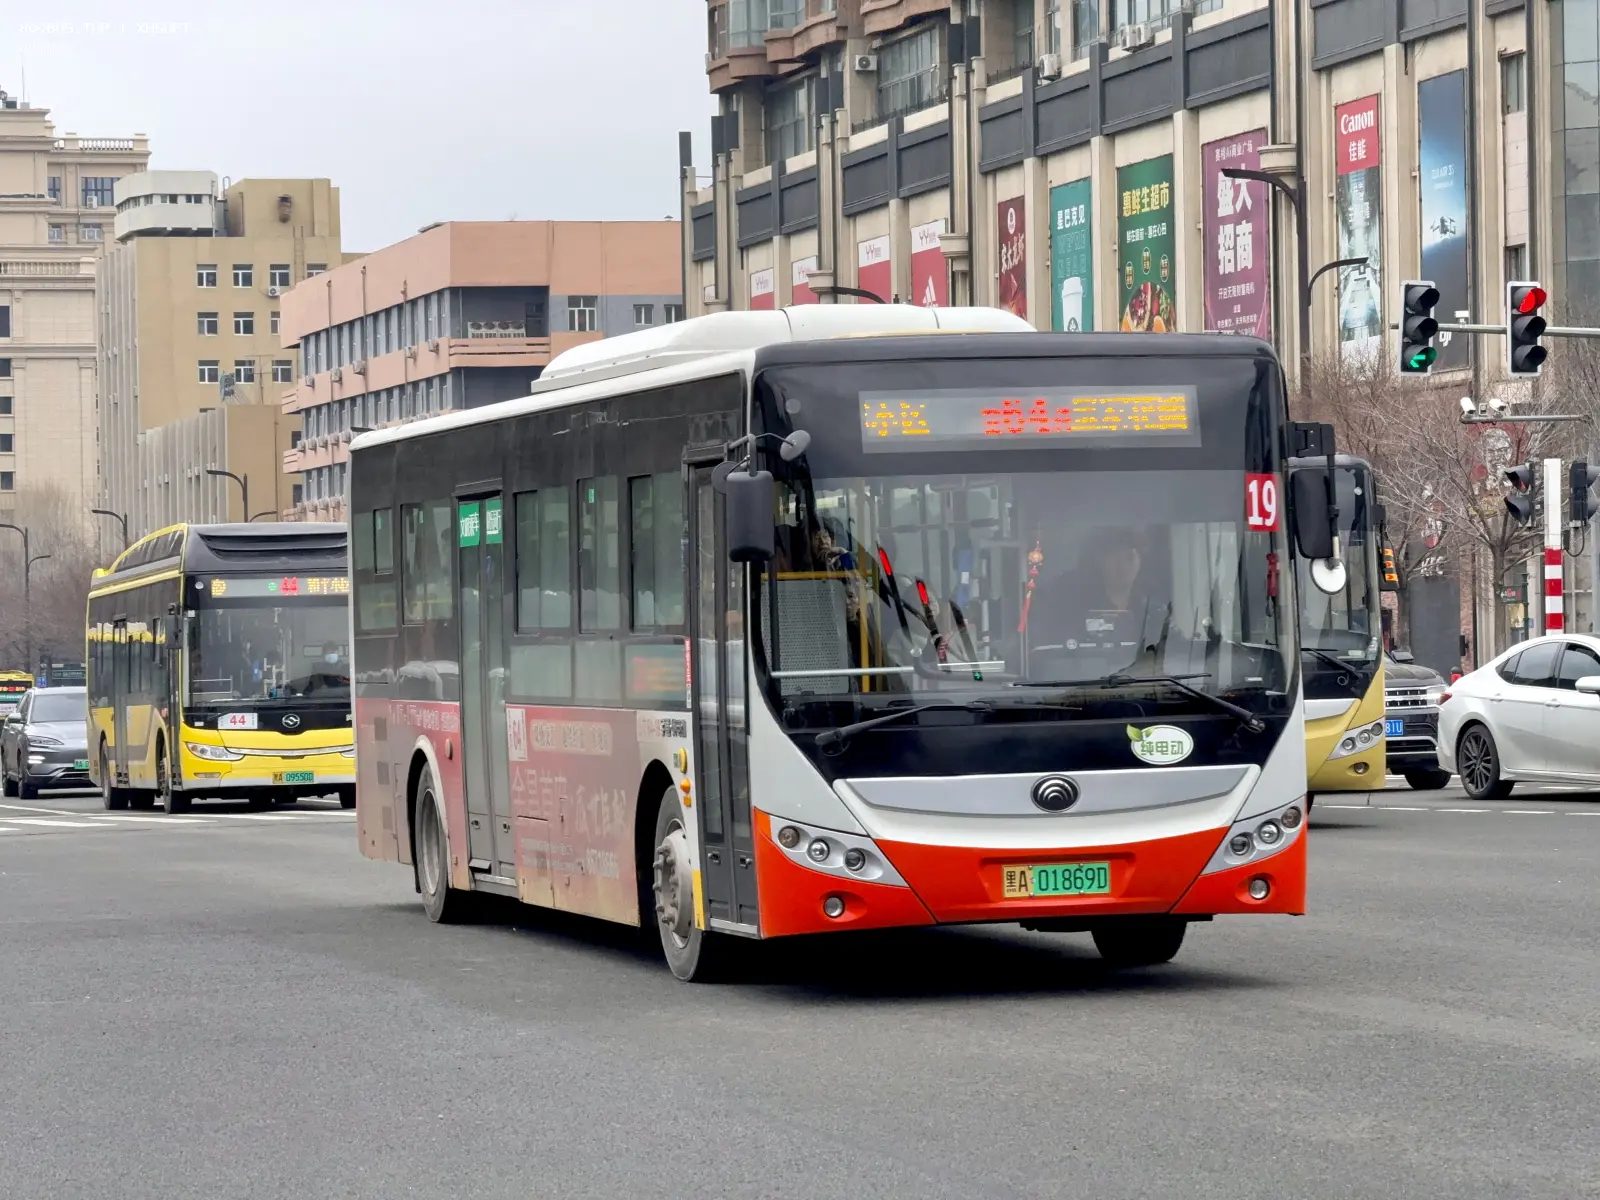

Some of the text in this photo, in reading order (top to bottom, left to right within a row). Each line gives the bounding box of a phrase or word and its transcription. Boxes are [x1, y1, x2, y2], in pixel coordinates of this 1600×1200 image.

[1340, 109, 1374, 135] Canon
[1348, 138, 1367, 162] 佳能
[1122, 182, 1169, 217] 惠鲜生超市
[1056, 204, 1086, 230] 星巴克见
[1217, 220, 1253, 275] 招商
[1248, 480, 1277, 527] 19
[230, 714, 247, 726] 44
[1140, 740, 1184, 756] 纯电动
[1005, 866, 1108, 893] 黑A 01869D
